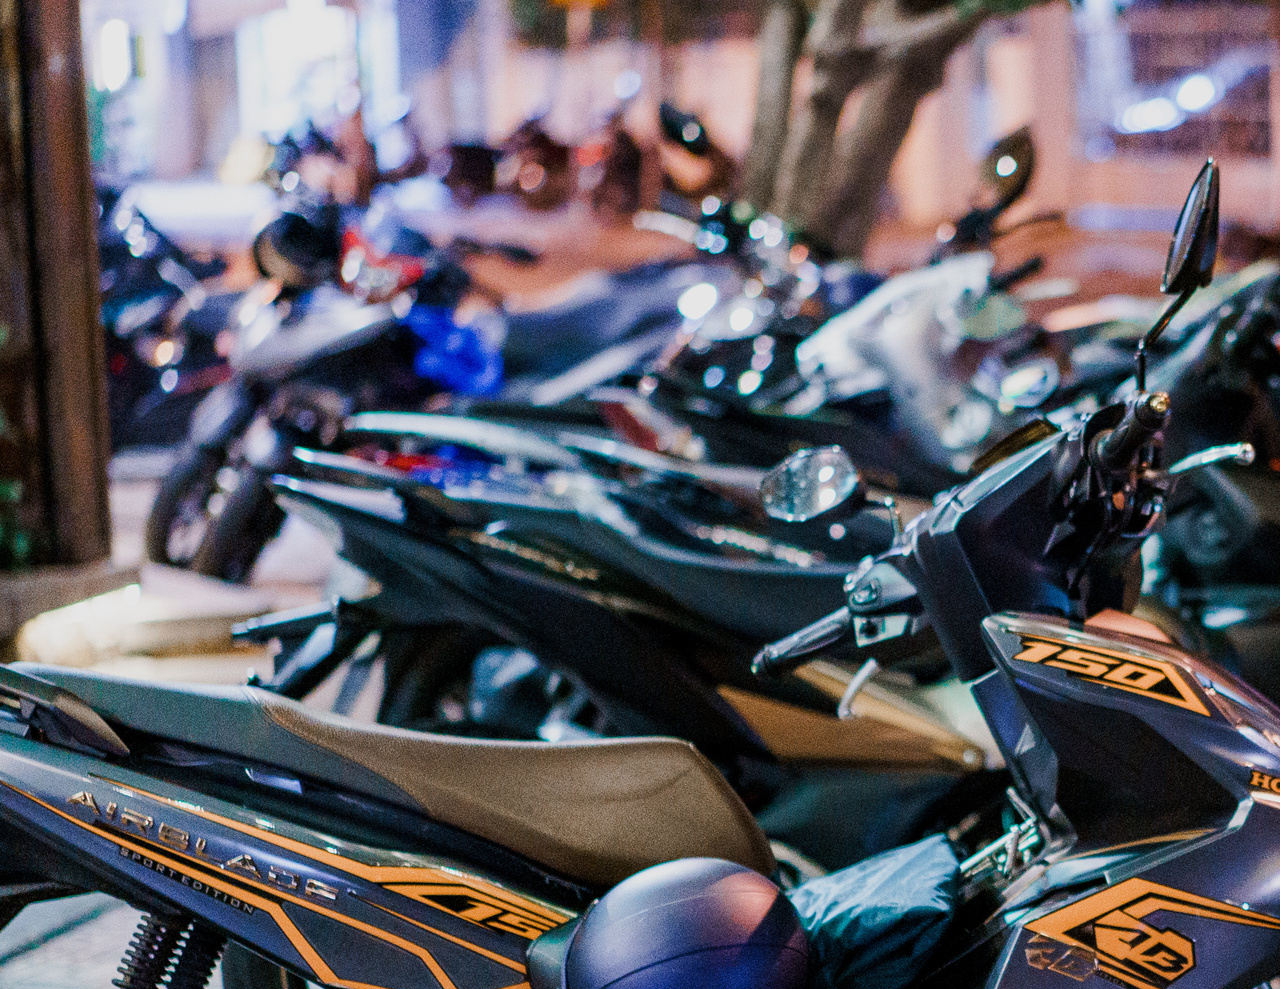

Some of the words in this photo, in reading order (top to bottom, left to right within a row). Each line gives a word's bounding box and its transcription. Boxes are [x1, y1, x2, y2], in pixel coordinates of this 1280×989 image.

[1013, 641, 1167, 690] 150
[119, 847, 177, 880] SPORT
[180, 874, 254, 915] EDITION
